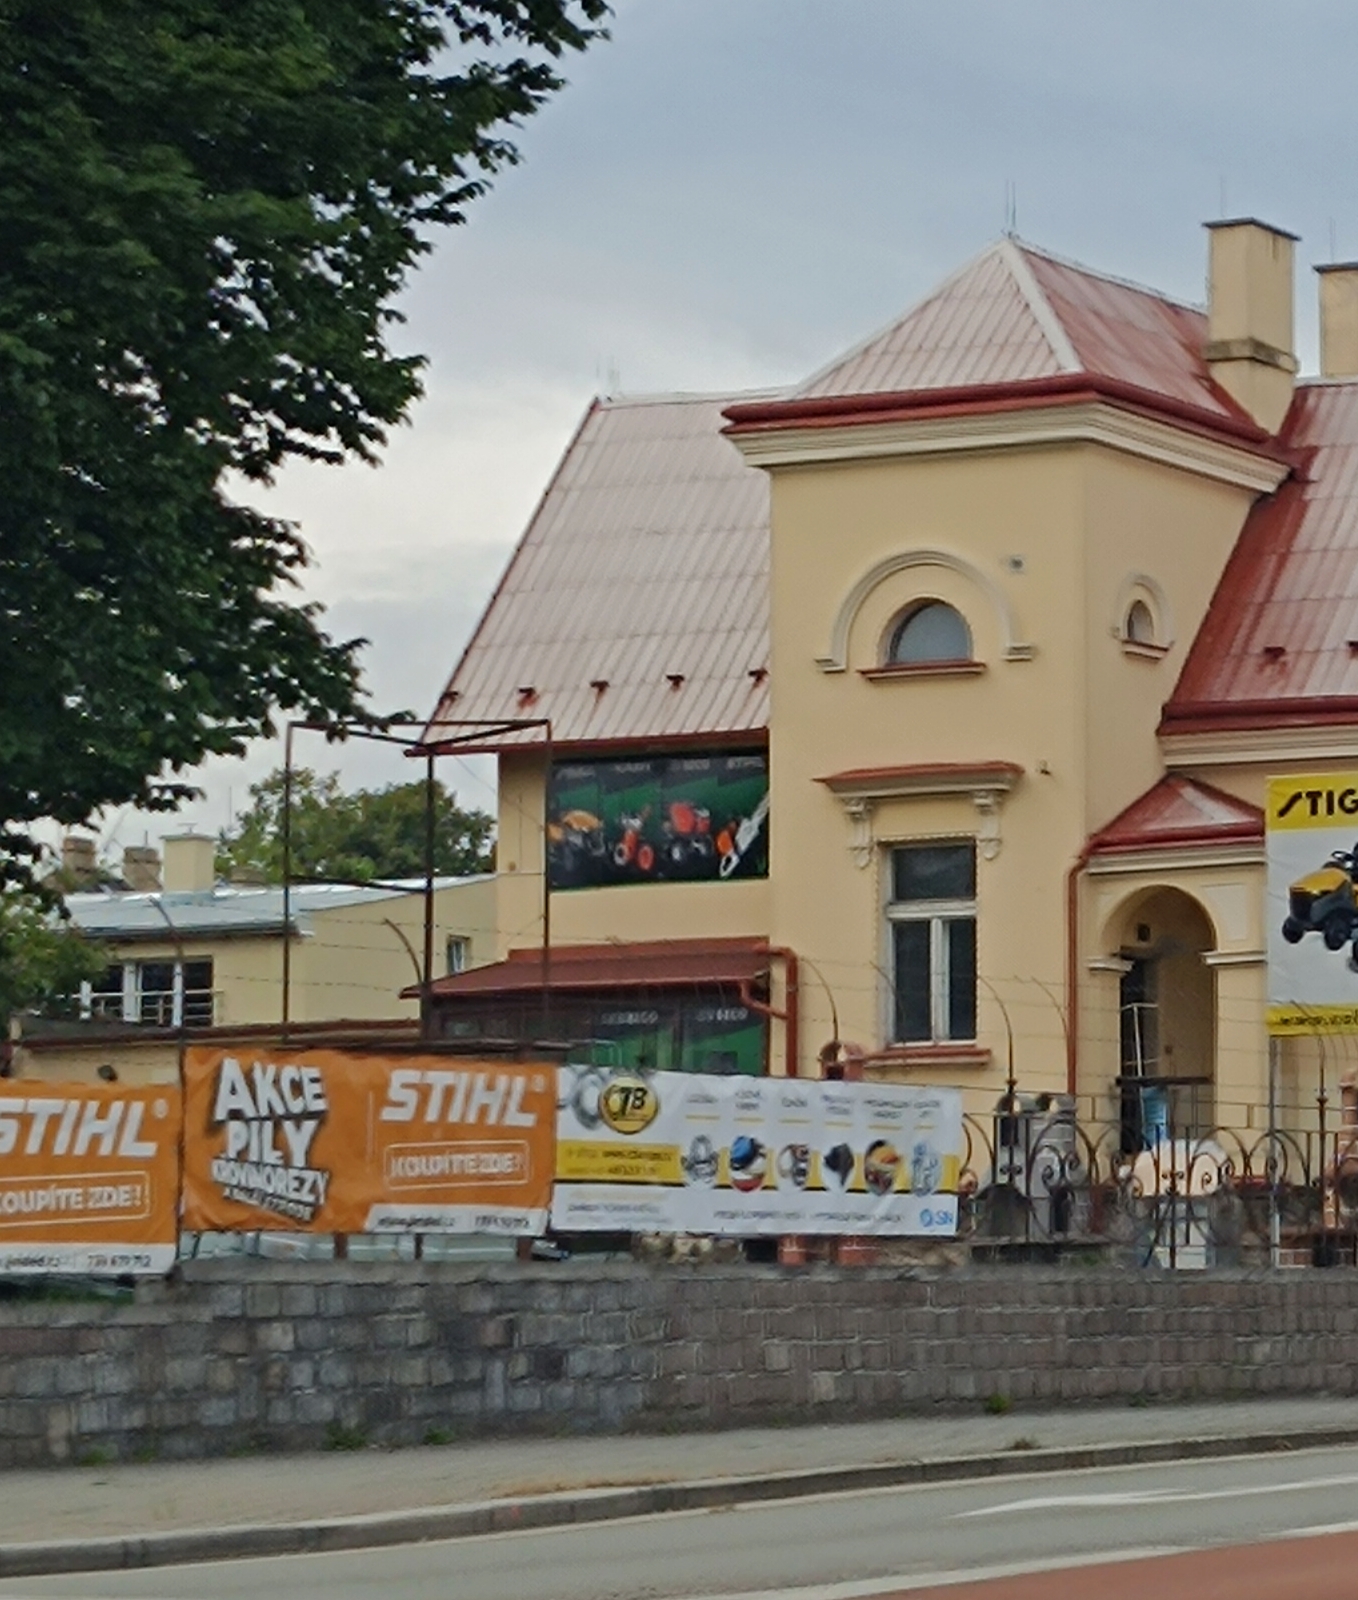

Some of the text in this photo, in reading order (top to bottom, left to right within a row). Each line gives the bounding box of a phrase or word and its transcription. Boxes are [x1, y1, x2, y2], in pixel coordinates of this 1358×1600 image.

[213, 1057, 327, 1121] AKCE
[380, 1069, 537, 1127] STIHL
[225, 1118, 318, 1169] PILY
[0, 1184, 83, 1214] OUPÍTE
